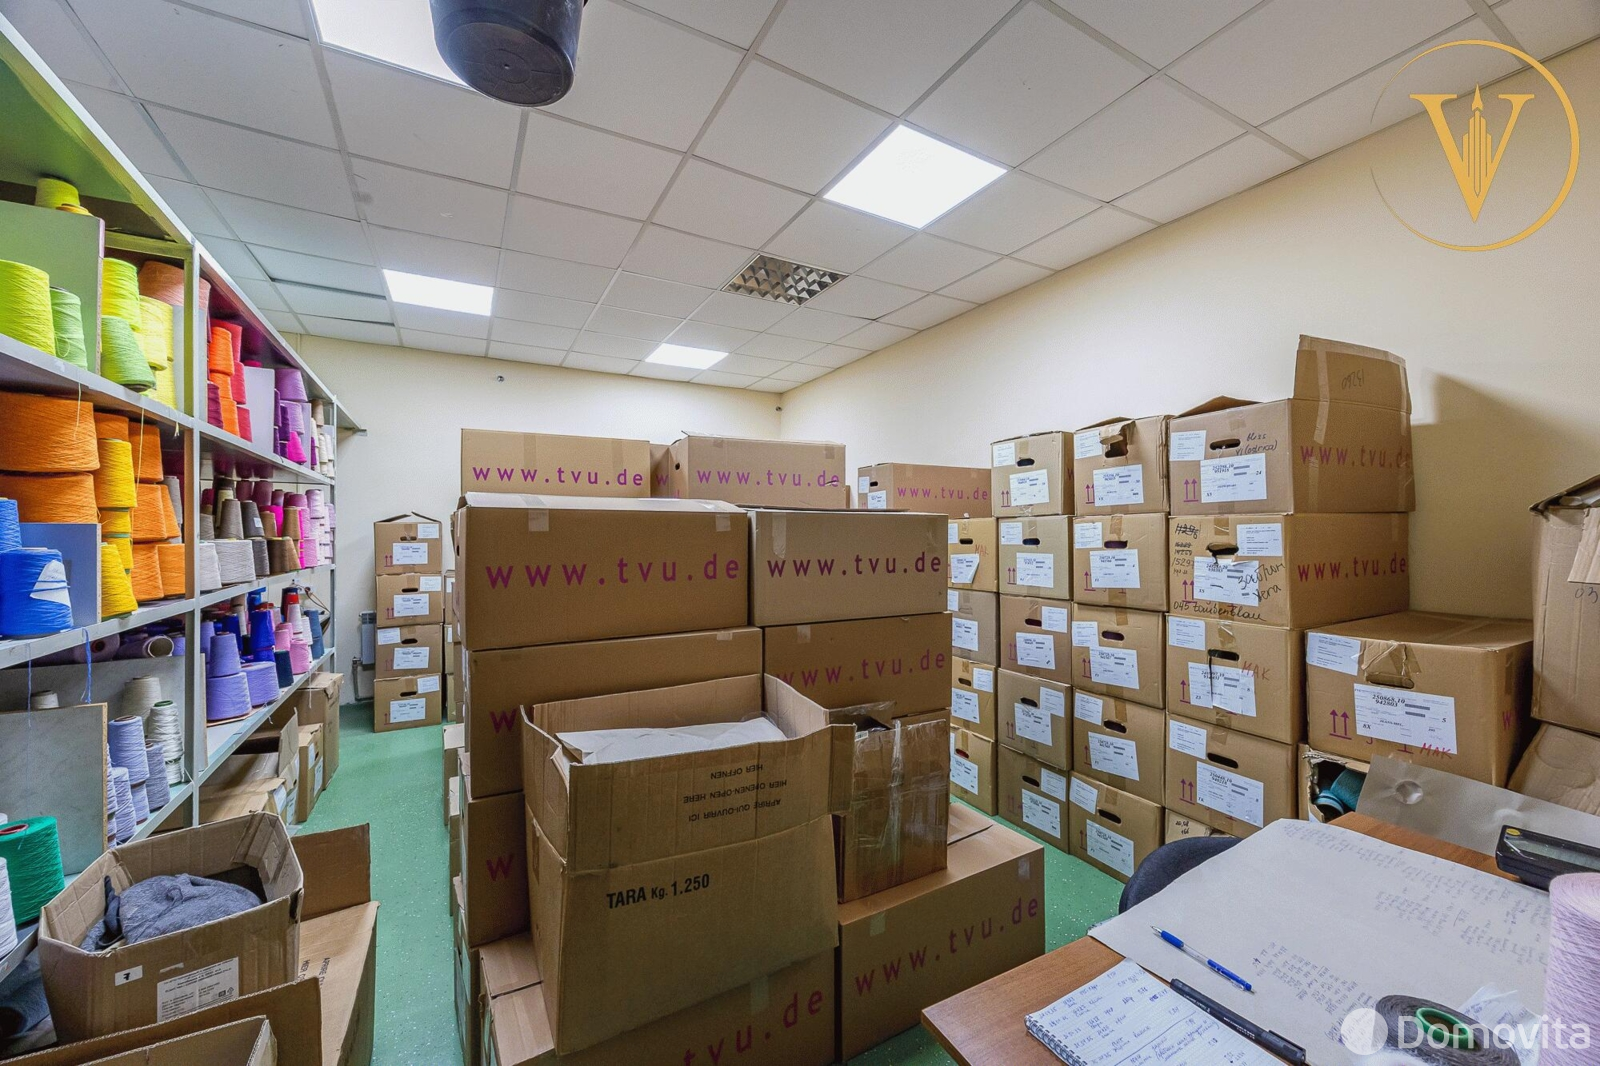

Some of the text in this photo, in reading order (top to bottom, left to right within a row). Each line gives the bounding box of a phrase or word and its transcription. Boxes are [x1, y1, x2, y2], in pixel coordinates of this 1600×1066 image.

[472, 466, 644, 487] www.tvu.de
[697, 468, 841, 488] www.tvu.de
[897, 486, 989, 500] www.tvu.de
[486, 553, 740, 590] www.tvu.de
[767, 552, 942, 577] www.tvu.de
[1297, 552, 1407, 583] www.tvu.de
[1173, 601, 1189, 611] 045
[746, 764, 763, 773] HIER
[769, 780, 788, 789] HIER
[683, 793, 706, 804] HERE
[753, 798, 782, 809] APRIRE
[688, 813, 700, 822] ICI
[606, 873, 710, 909] TARA Kg. 1.250
[853, 894, 1040, 996] www.tvu.de
